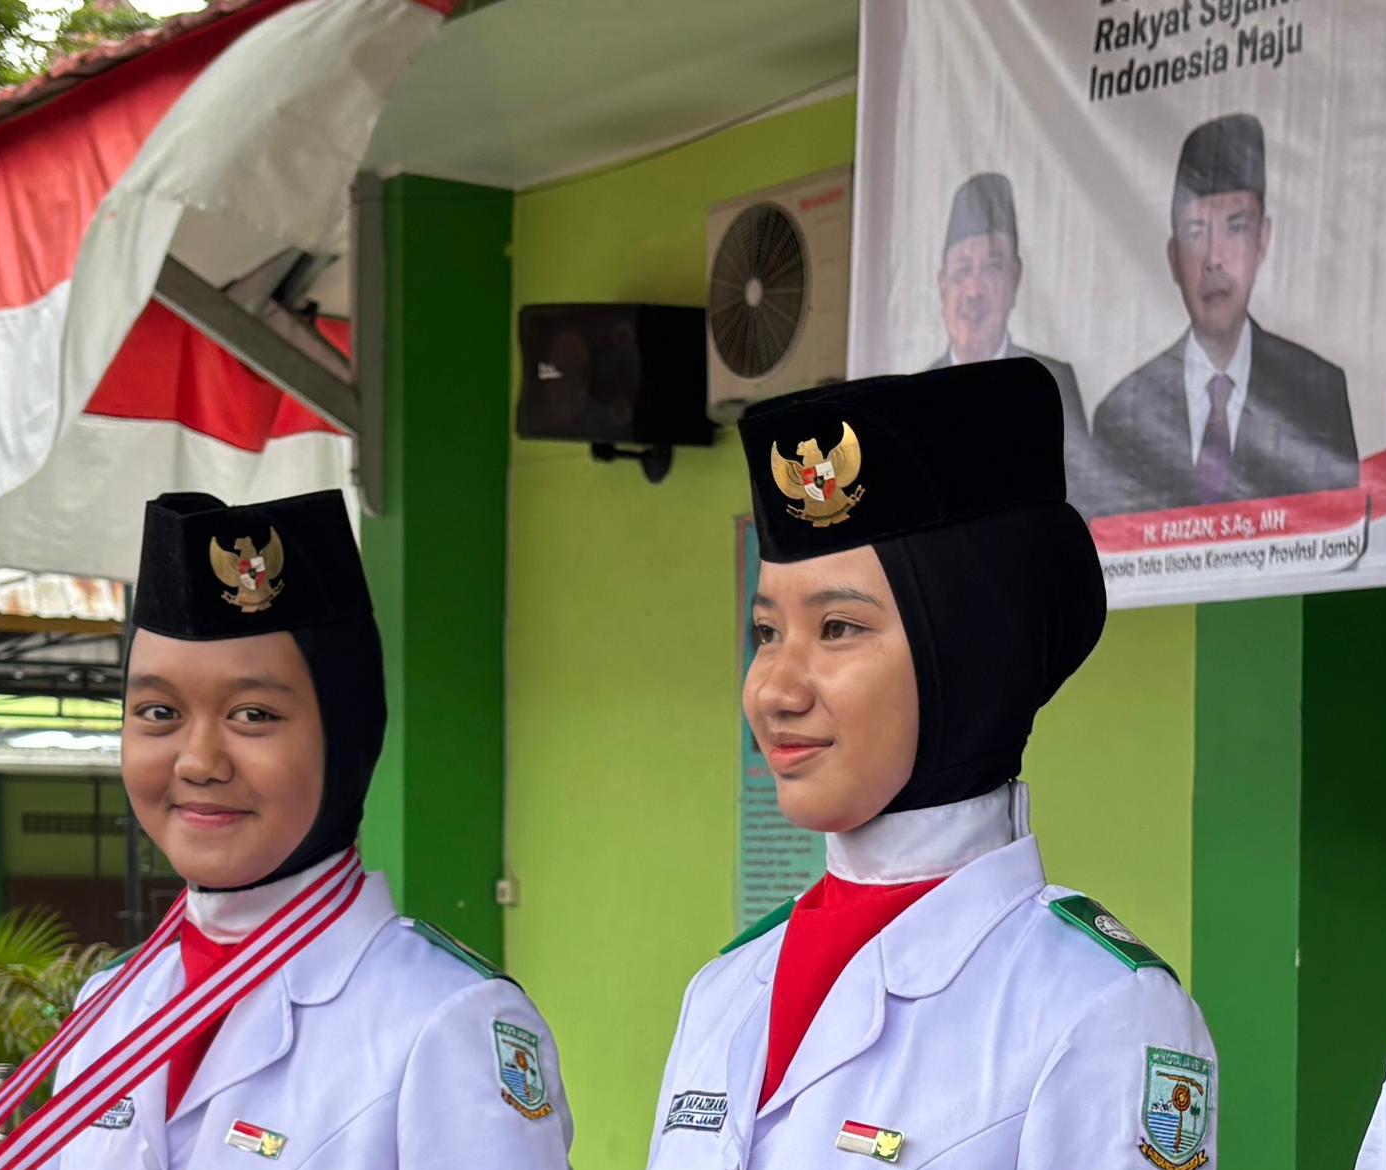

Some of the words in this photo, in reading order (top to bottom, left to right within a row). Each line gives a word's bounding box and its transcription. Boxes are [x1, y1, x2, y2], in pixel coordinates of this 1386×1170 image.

[1089, 37, 1229, 102] Indonesia
[1236, 17, 1303, 68] Maju
[1094, 1, 1192, 53] Rakyat
